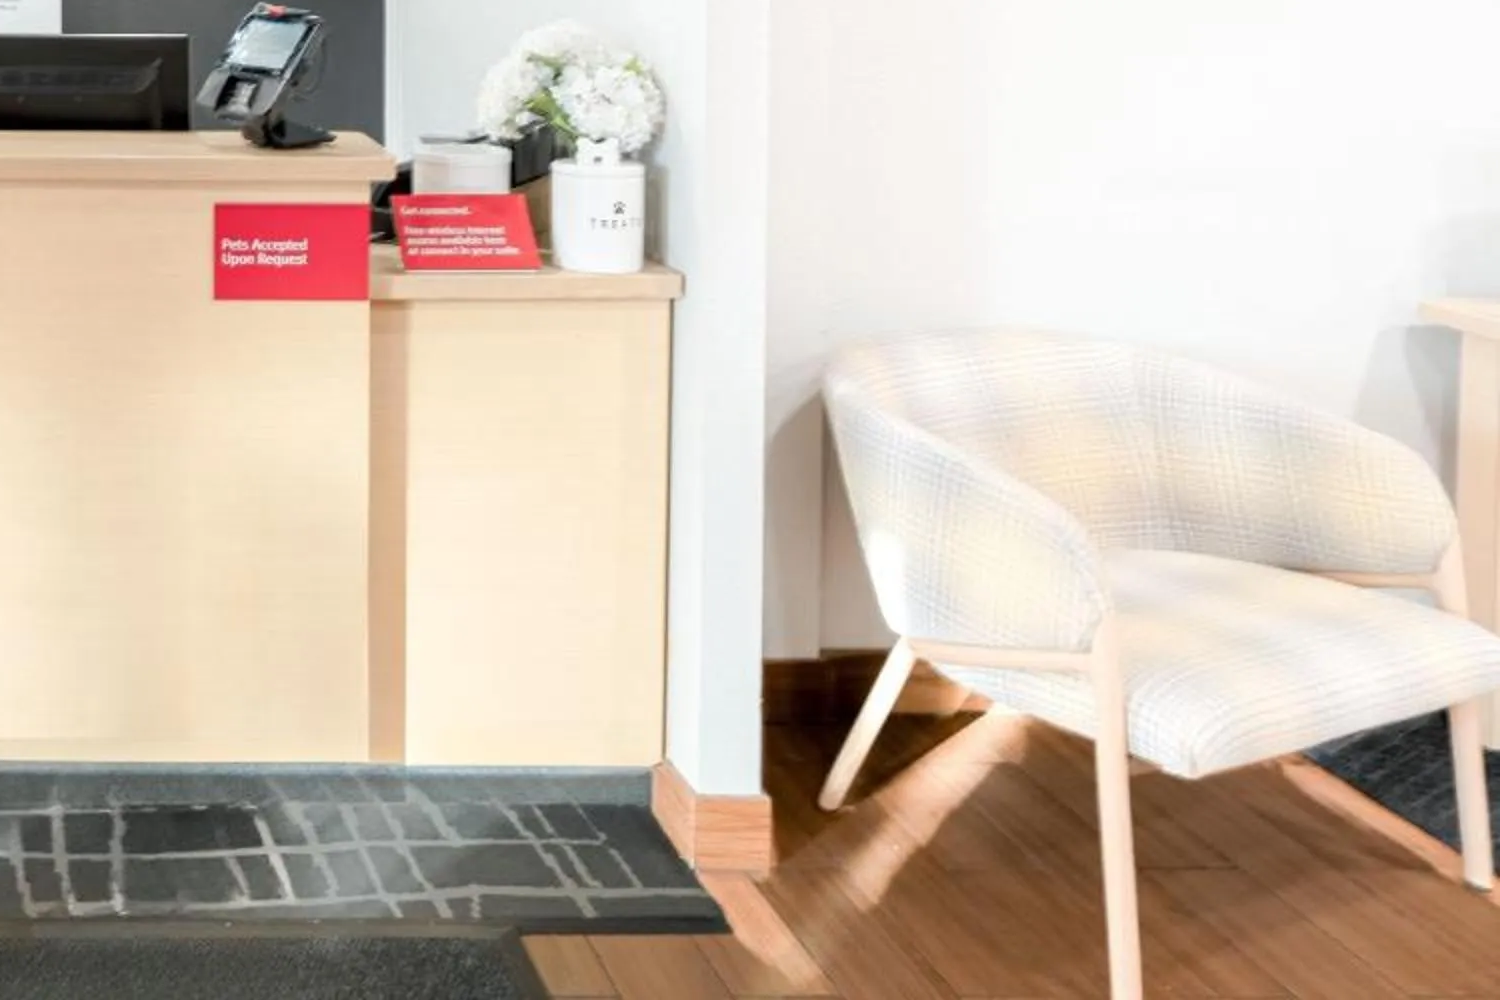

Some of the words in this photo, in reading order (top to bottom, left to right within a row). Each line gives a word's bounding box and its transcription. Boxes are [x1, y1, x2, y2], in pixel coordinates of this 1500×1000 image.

[221, 237, 249, 251] Pets
[251, 237, 309, 253] Accepted
[221, 252, 255, 268] Upon
[257, 252, 309, 268] Request
